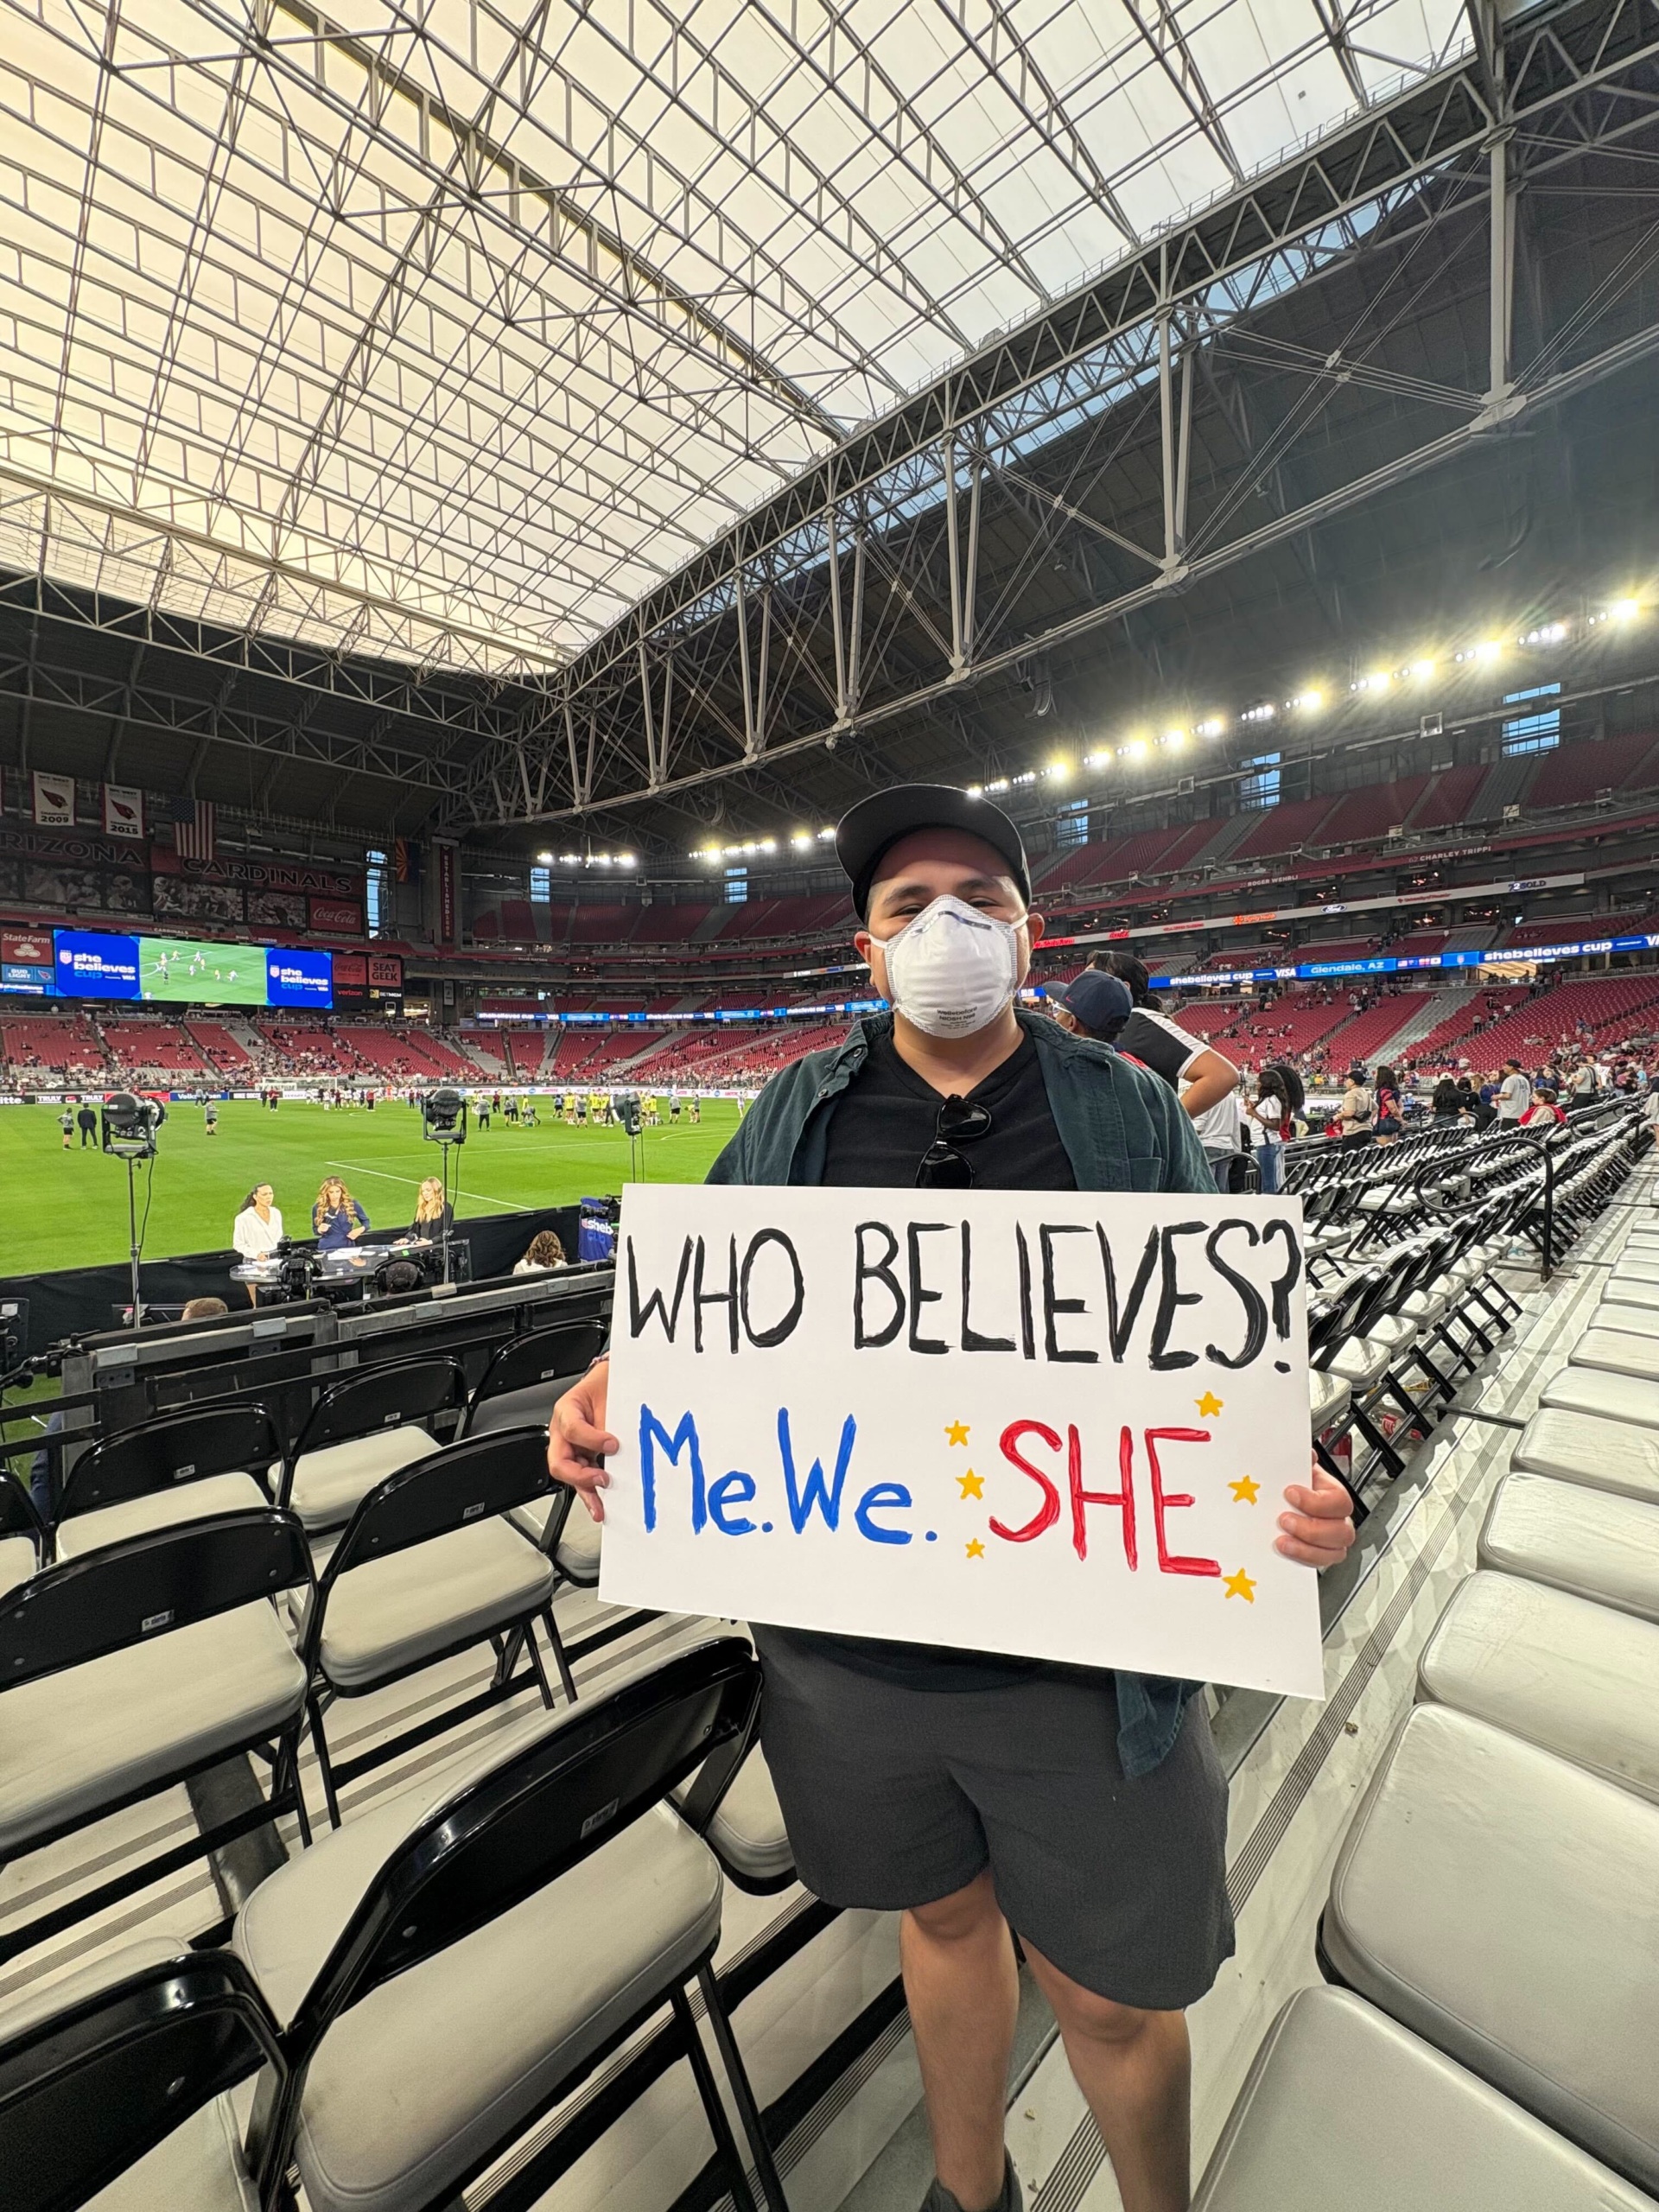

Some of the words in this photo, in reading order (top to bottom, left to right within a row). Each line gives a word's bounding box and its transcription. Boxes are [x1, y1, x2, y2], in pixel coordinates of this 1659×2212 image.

[110, 824, 138, 835] 2015
[1420, 850, 1459, 861] CHARLEY
[1462, 846, 1491, 855] TRIPPI
[181, 858, 352, 893] CARDINALS
[1247, 879, 1270, 887] ROGER
[1271, 874, 1299, 883] WEHRLI
[1508, 880, 1547, 893] 72SOLD
[1484, 944, 1580, 961] shebelieves
[1582, 941, 1612, 952] cup
[73, 953, 102, 963] she
[73, 962, 136, 973] believes
[372, 962, 397, 972] SEAT
[1368, 961, 1384, 970] AZ
[73, 970, 103, 979] cup
[281, 968, 302, 976] she
[372, 972, 397, 982] GEEK
[1170, 973, 1232, 985] shebelieves
[1233, 971, 1253, 981] cup
[1274, 968, 1297, 978] VISA
[281, 976, 328, 986] believes
[627, 1227, 804, 1355] WHO
[855, 1218, 1302, 1373] BELIEVES?
[988, 1419, 1223, 1578] SHE
